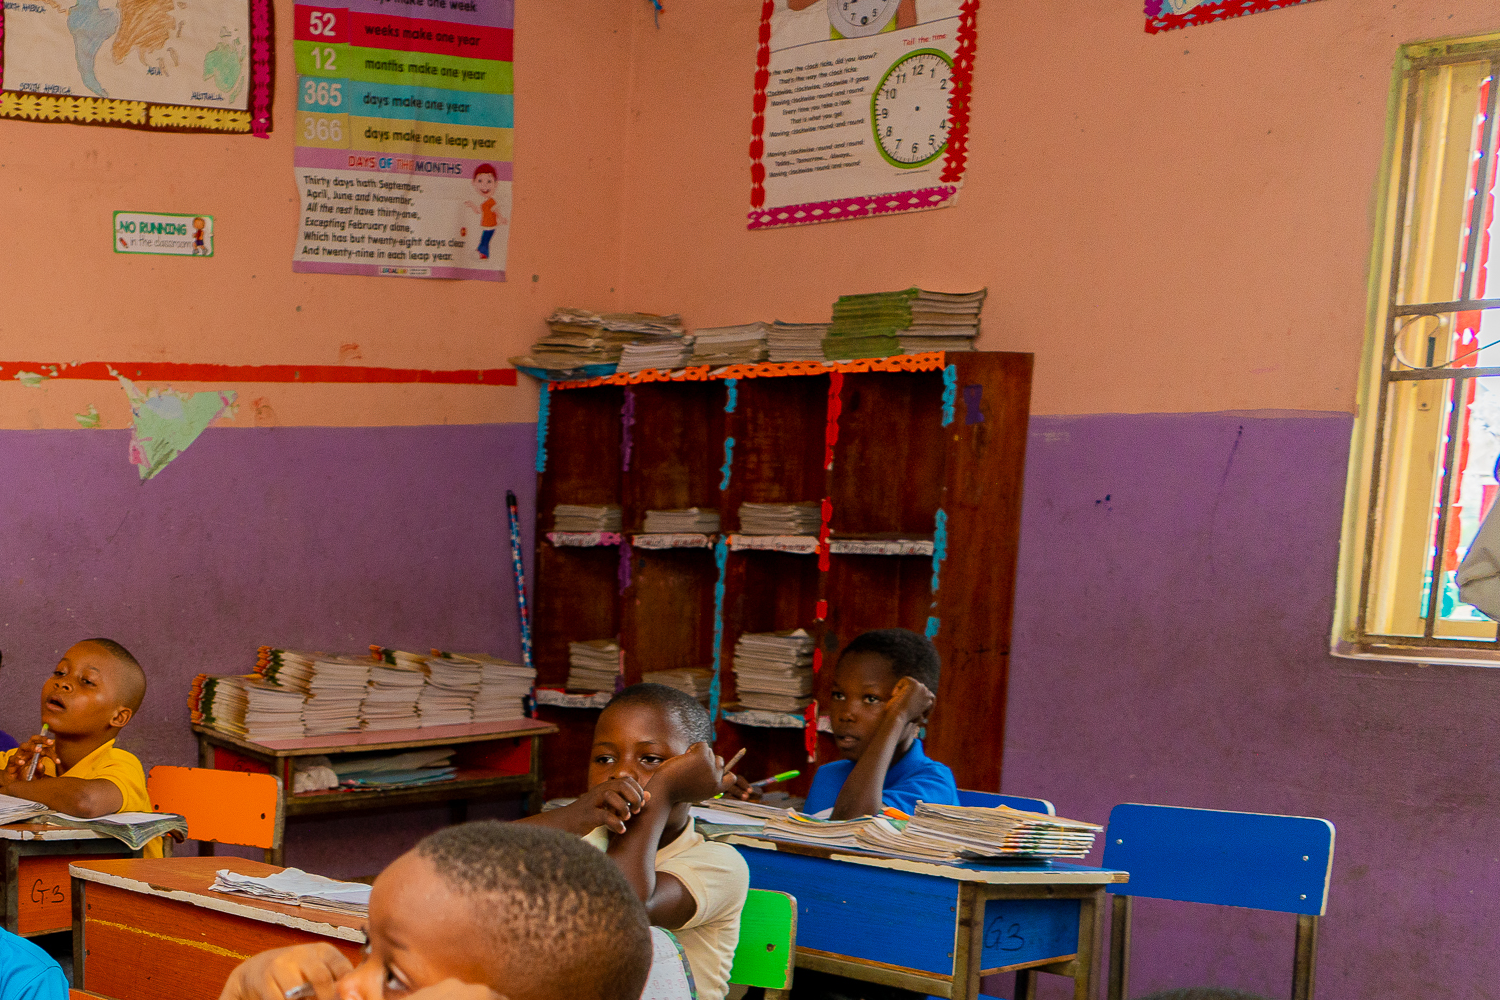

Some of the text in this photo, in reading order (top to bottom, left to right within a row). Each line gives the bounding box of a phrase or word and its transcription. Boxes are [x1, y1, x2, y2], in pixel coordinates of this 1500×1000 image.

[450, 1, 477, 12] week
[310, 12, 480, 47] 52 weeks make one year
[311, 48, 486, 81] 12 months make one year
[912, 64, 924, 76] 12
[896, 73, 906, 84] 11
[930, 68, 935, 78] 1
[940, 79, 946, 90] 2
[304, 81, 470, 114] 365 days make one year
[885, 88, 896, 100] 10
[882, 108, 888, 118] 9
[940, 120, 946, 130] 4
[304, 117, 496, 150] 366 days make one leap year
[886, 126, 892, 137] 8
[896, 139, 902, 150] 7
[929, 135, 935, 145] 5
[912, 142, 919, 153] 6
[349, 156, 462, 174] DAYS OF THE MONTHS
[304, 176, 424, 193] Thirty days hath September,
[333, 191, 352, 200] June
[355, 192, 370, 201] and
[306, 203, 317, 212] All
[320, 204, 333, 213] the
[336, 206, 352, 215] rest
[354, 205, 374, 216] have
[120, 221, 186, 235] NO RUNNING
[305, 217, 346, 230] Excepting
[348, 220, 387, 232] February
[139, 238, 152, 247] the
[304, 231, 329, 242] Which
[332, 232, 347, 242] has
[350, 233, 365, 243] but
[368, 235, 422, 249] twenty-eight
[425, 238, 446, 250] days
[302, 246, 319, 255] And
[322, 247, 374, 259] twenty-nine
[377, 249, 385, 258] in
[388, 250, 406, 260] each
[409, 251, 429, 261] leap
[985, 916, 1024, 952] G3
